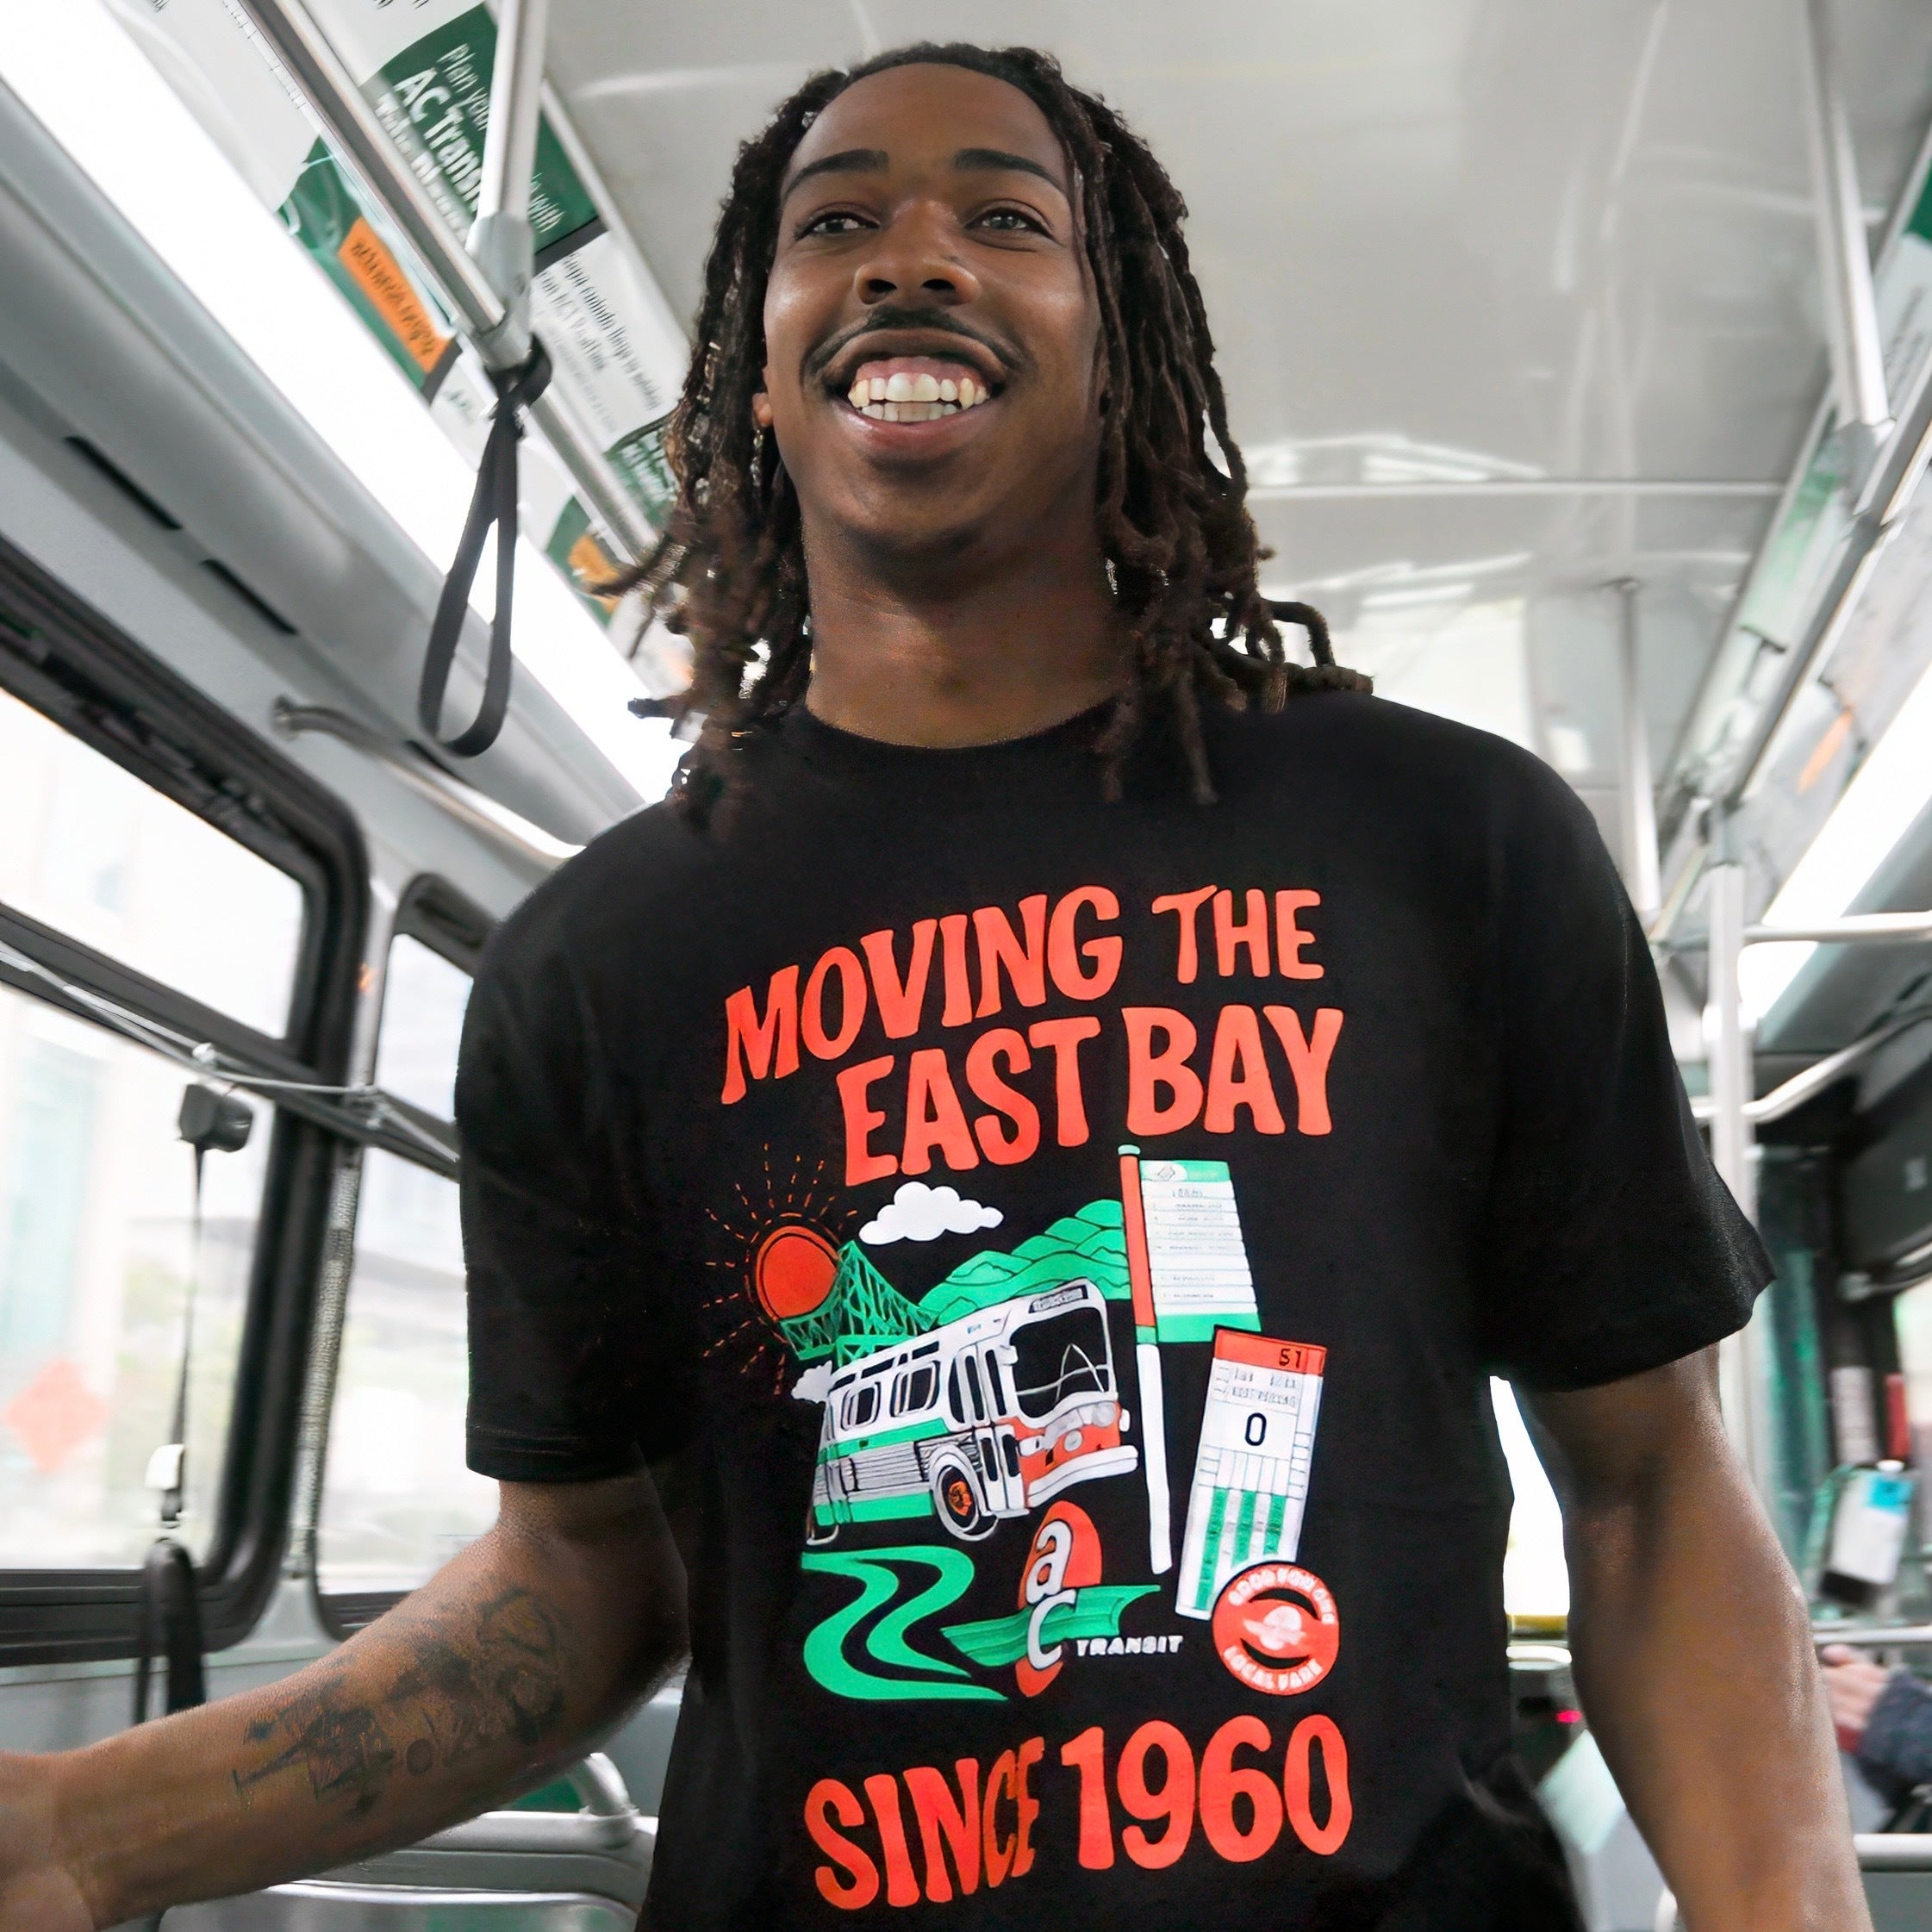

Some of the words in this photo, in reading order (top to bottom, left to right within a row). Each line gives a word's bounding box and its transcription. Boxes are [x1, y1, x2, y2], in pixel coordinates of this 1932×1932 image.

[393, 67, 452, 123] AC
[423, 105, 483, 213] Trans
[435, 43, 479, 94] Plan
[721, 885, 1123, 1105] MOVING
[1151, 884, 1324, 984] THE
[837, 1017, 1101, 1187] EAST
[1121, 1005, 1344, 1137] BAY
[1076, 1635, 1183, 1656] TRANSIT
[805, 1736, 1044, 1910] SINCE
[1061, 1715, 1353, 1870] 1960
